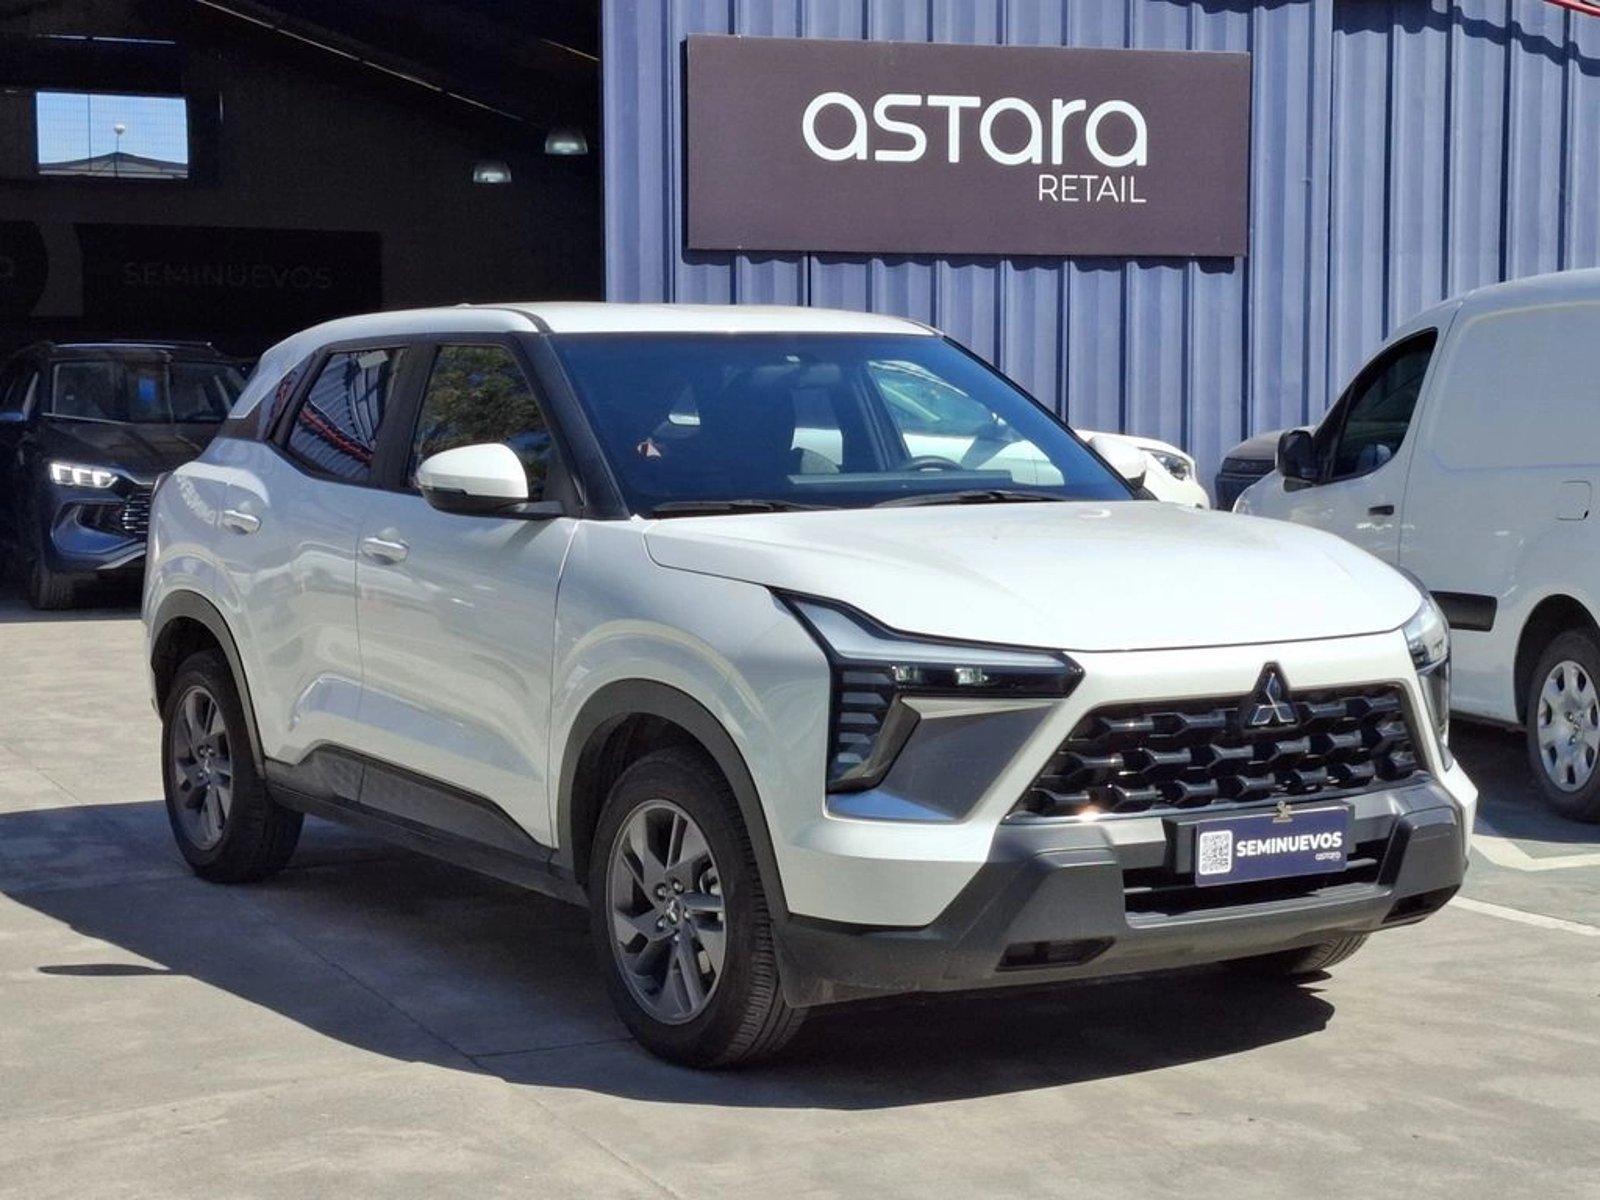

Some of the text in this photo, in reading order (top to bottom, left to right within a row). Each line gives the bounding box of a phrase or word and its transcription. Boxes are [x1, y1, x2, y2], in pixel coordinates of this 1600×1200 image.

[1038, 174, 1147, 204] RETAIL
[123, 261, 332, 289] SEMINUEVOS
[1236, 831, 1342, 857] SEMINUEVOS
